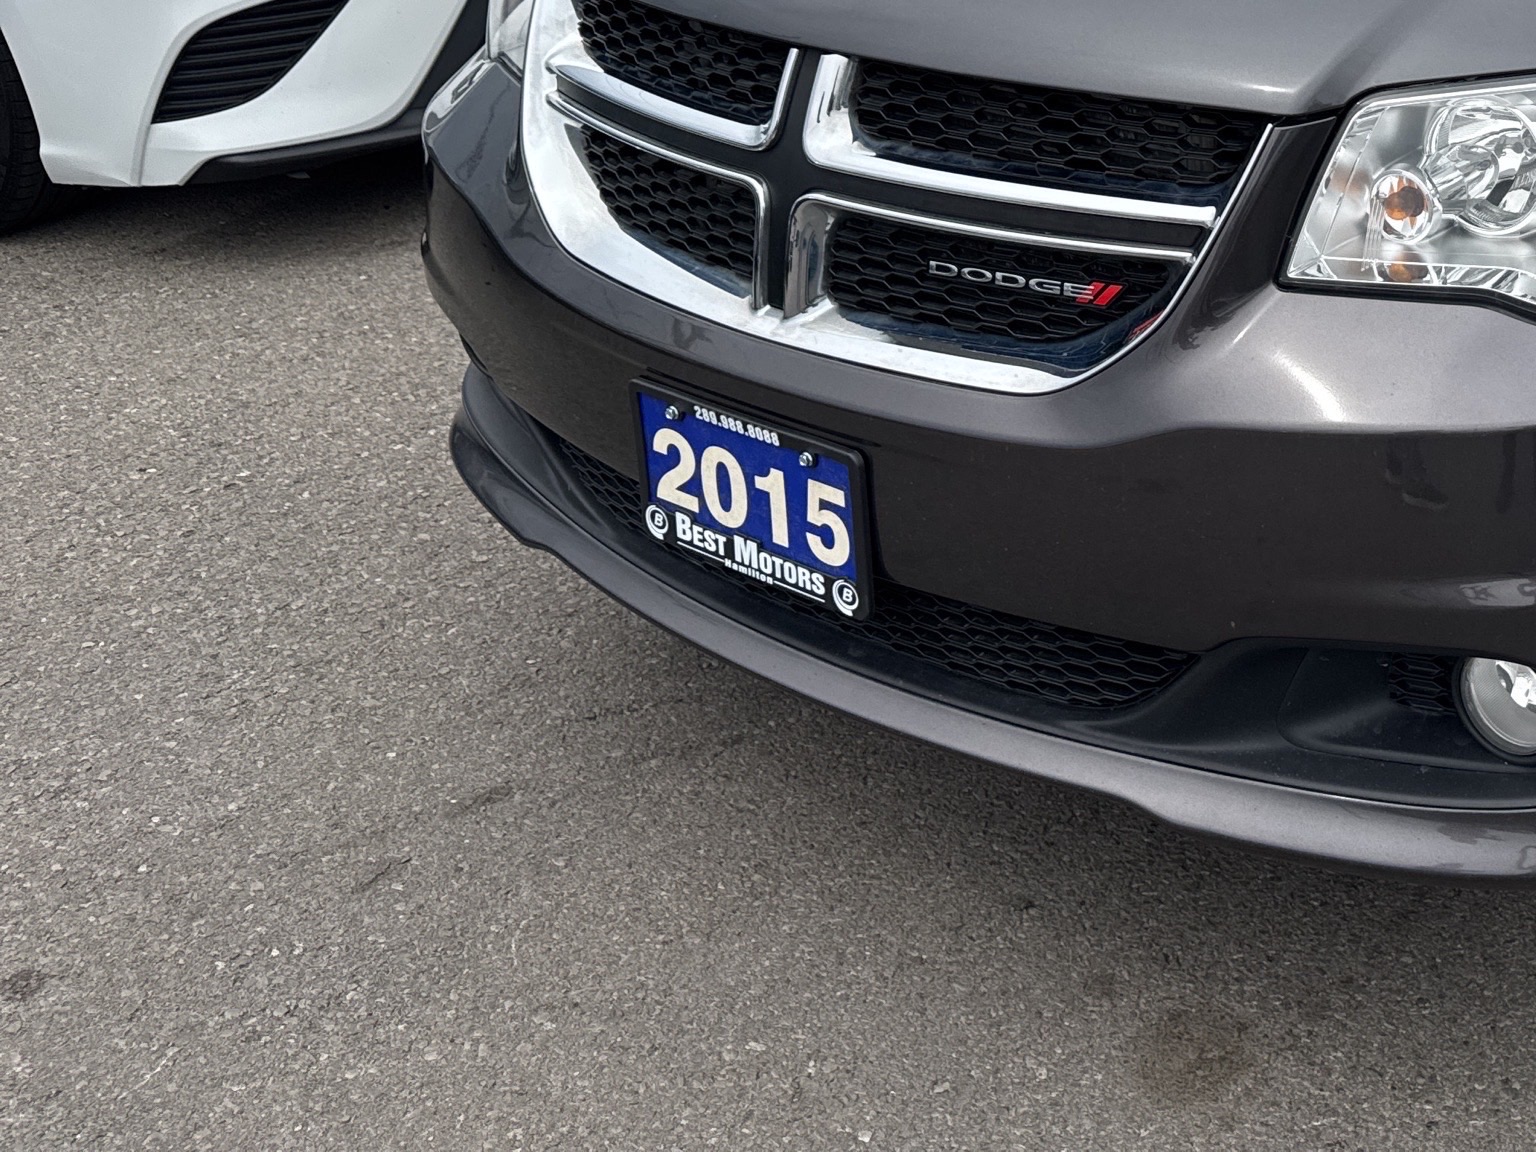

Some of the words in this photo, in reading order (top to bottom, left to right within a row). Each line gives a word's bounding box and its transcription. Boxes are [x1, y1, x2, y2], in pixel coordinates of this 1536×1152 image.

[928, 260, 1094, 300] DODGE
[693, 404, 780, 447] 289.988.8088
[652, 427, 850, 567] 2015
[675, 511, 727, 557] BEST
[733, 534, 826, 596] MOTORS
[724, 556, 774, 585] Hamilton
